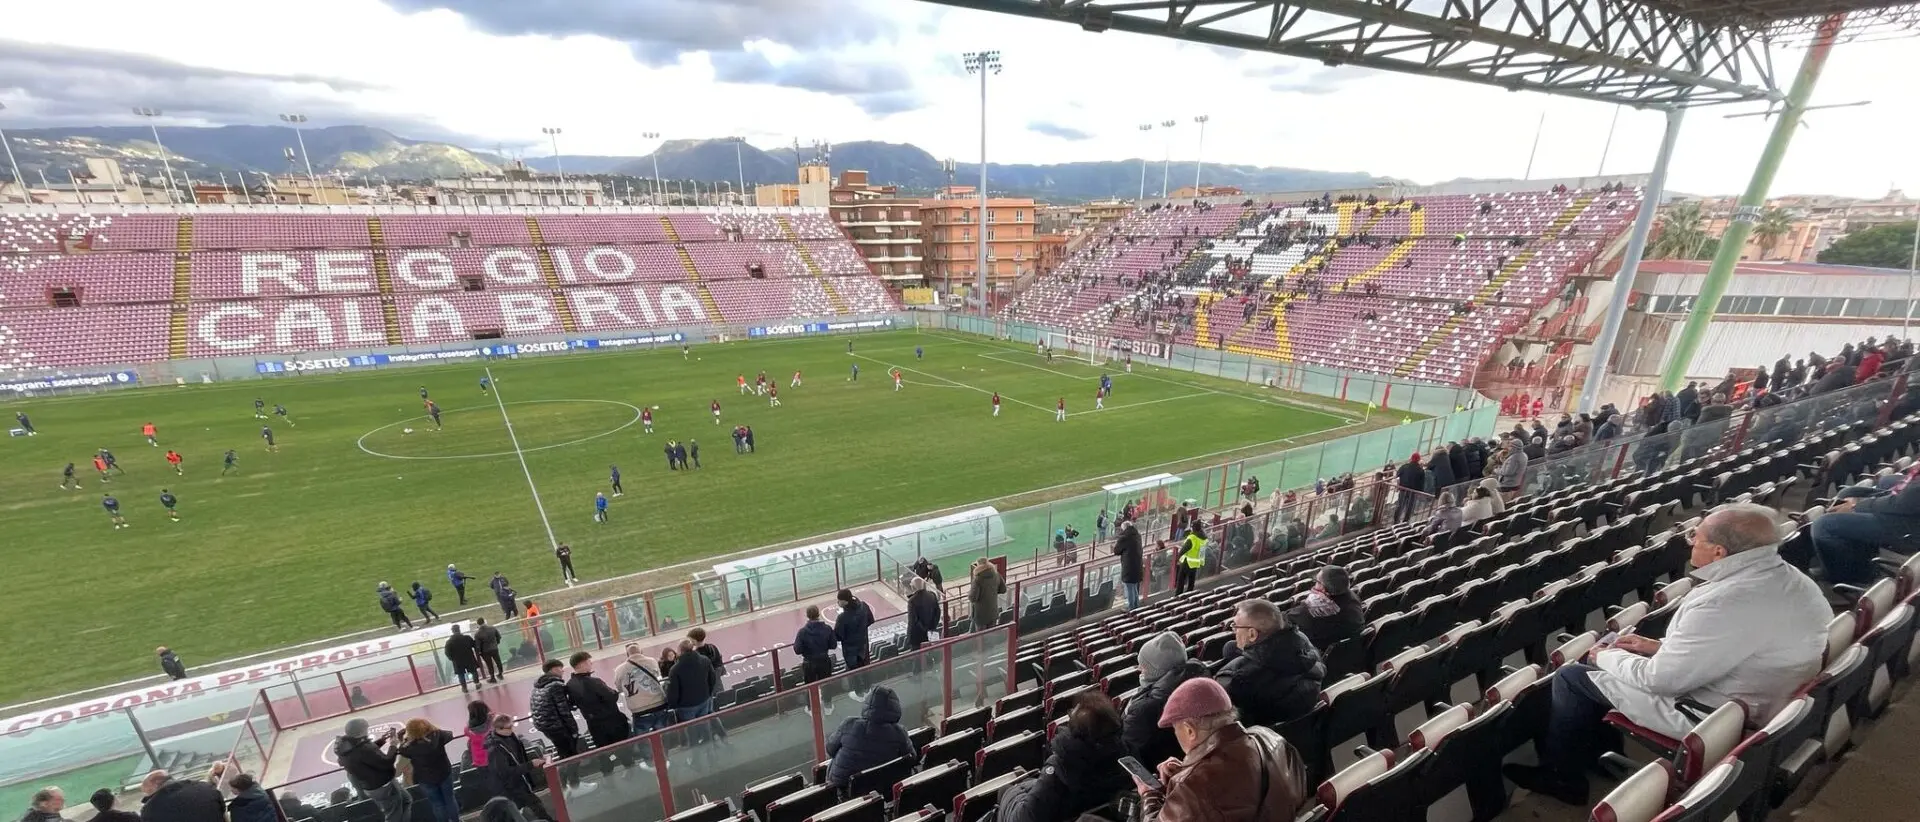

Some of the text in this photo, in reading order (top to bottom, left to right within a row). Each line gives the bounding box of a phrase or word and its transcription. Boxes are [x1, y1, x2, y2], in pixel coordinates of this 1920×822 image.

[240, 245, 636, 294] REGGIO
[197, 283, 708, 349] CALABRIA
[766, 325, 805, 335] SOSETEG
[517, 341, 568, 353] SOSETEG
[1131, 340, 1160, 356] SUD
[388, 352, 437, 363] Instagram:
[284, 358, 350, 371] SOSETEG
[51, 374, 113, 387] sosetegsrl
[8, 641, 393, 738] CORONA PETROLI
